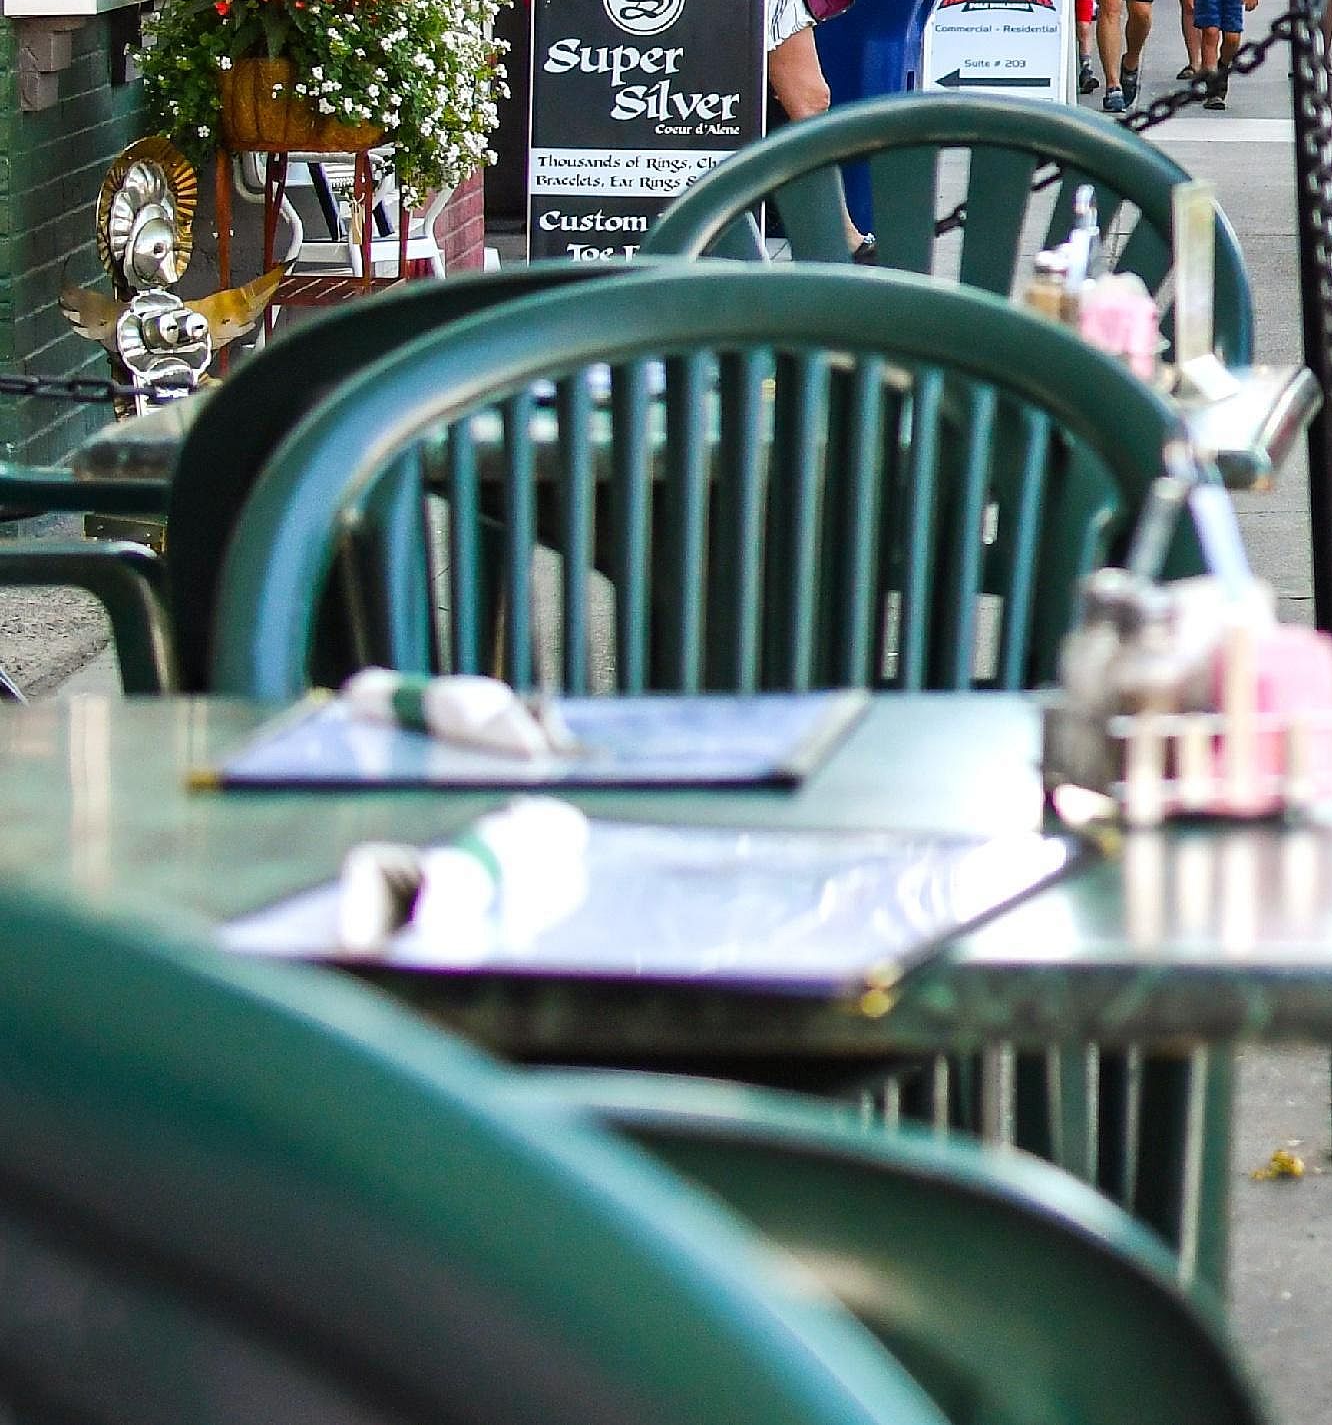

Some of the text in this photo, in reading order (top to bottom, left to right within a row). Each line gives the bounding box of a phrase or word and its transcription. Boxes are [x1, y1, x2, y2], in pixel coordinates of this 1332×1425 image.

[935, 24, 992, 32] Commercial
[1003, 24, 1058, 32] Residential
[543, 38, 684, 87] Super
[964, 59, 990, 68] Suite
[1005, 59, 1027, 68] 203
[610, 79, 740, 121] Silver
[655, 123, 740, 135] Coeur d'Alene
[537, 154, 621, 168] Thousands
[625, 155, 641, 168] of
[646, 157, 692, 173] Rings,
[536, 174, 604, 188] Bracelets,
[610, 176, 633, 187] Ear
[639, 176, 681, 191] Rings
[539, 207, 649, 232] Custom
[566, 243, 614, 263] Toe
